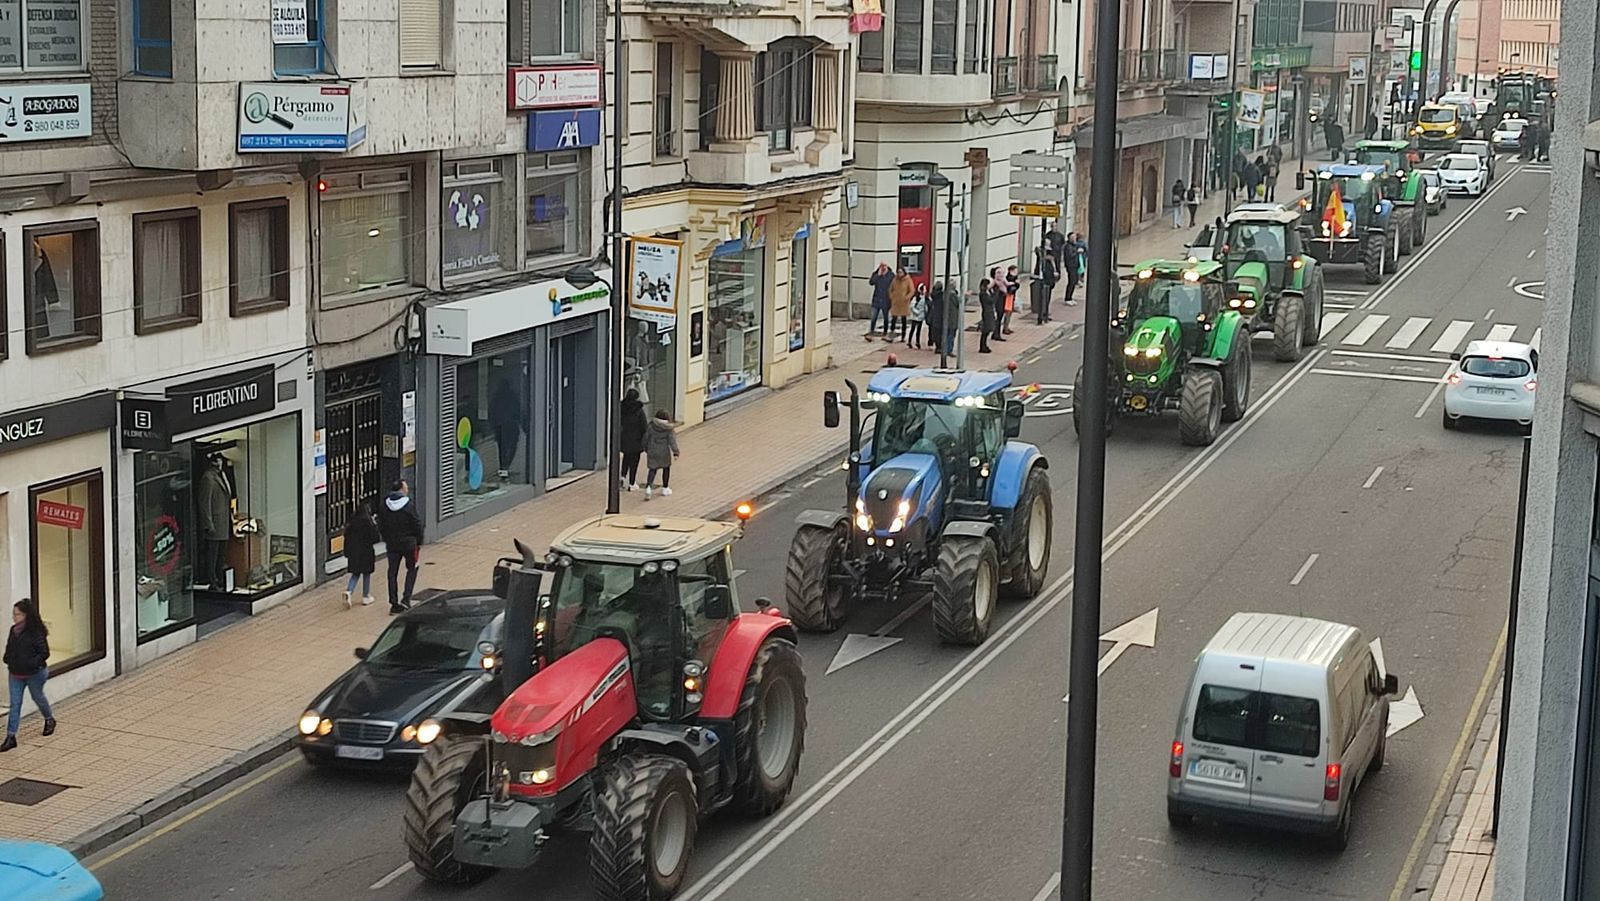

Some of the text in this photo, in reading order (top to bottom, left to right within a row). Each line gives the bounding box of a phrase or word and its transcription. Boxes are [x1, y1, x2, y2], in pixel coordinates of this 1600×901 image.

[28, 9, 52, 21] DEFENSA
[281, 8, 304, 20] ALQUILA
[25, 98, 78, 113] ABOGADOS
[273, 96, 334, 117] Pérgamo
[557, 121, 580, 147] AXA
[193, 383, 258, 414] FLORENTINO
[0, 418, 43, 443] NGUEZ
[43, 506, 80, 520] REMATES
